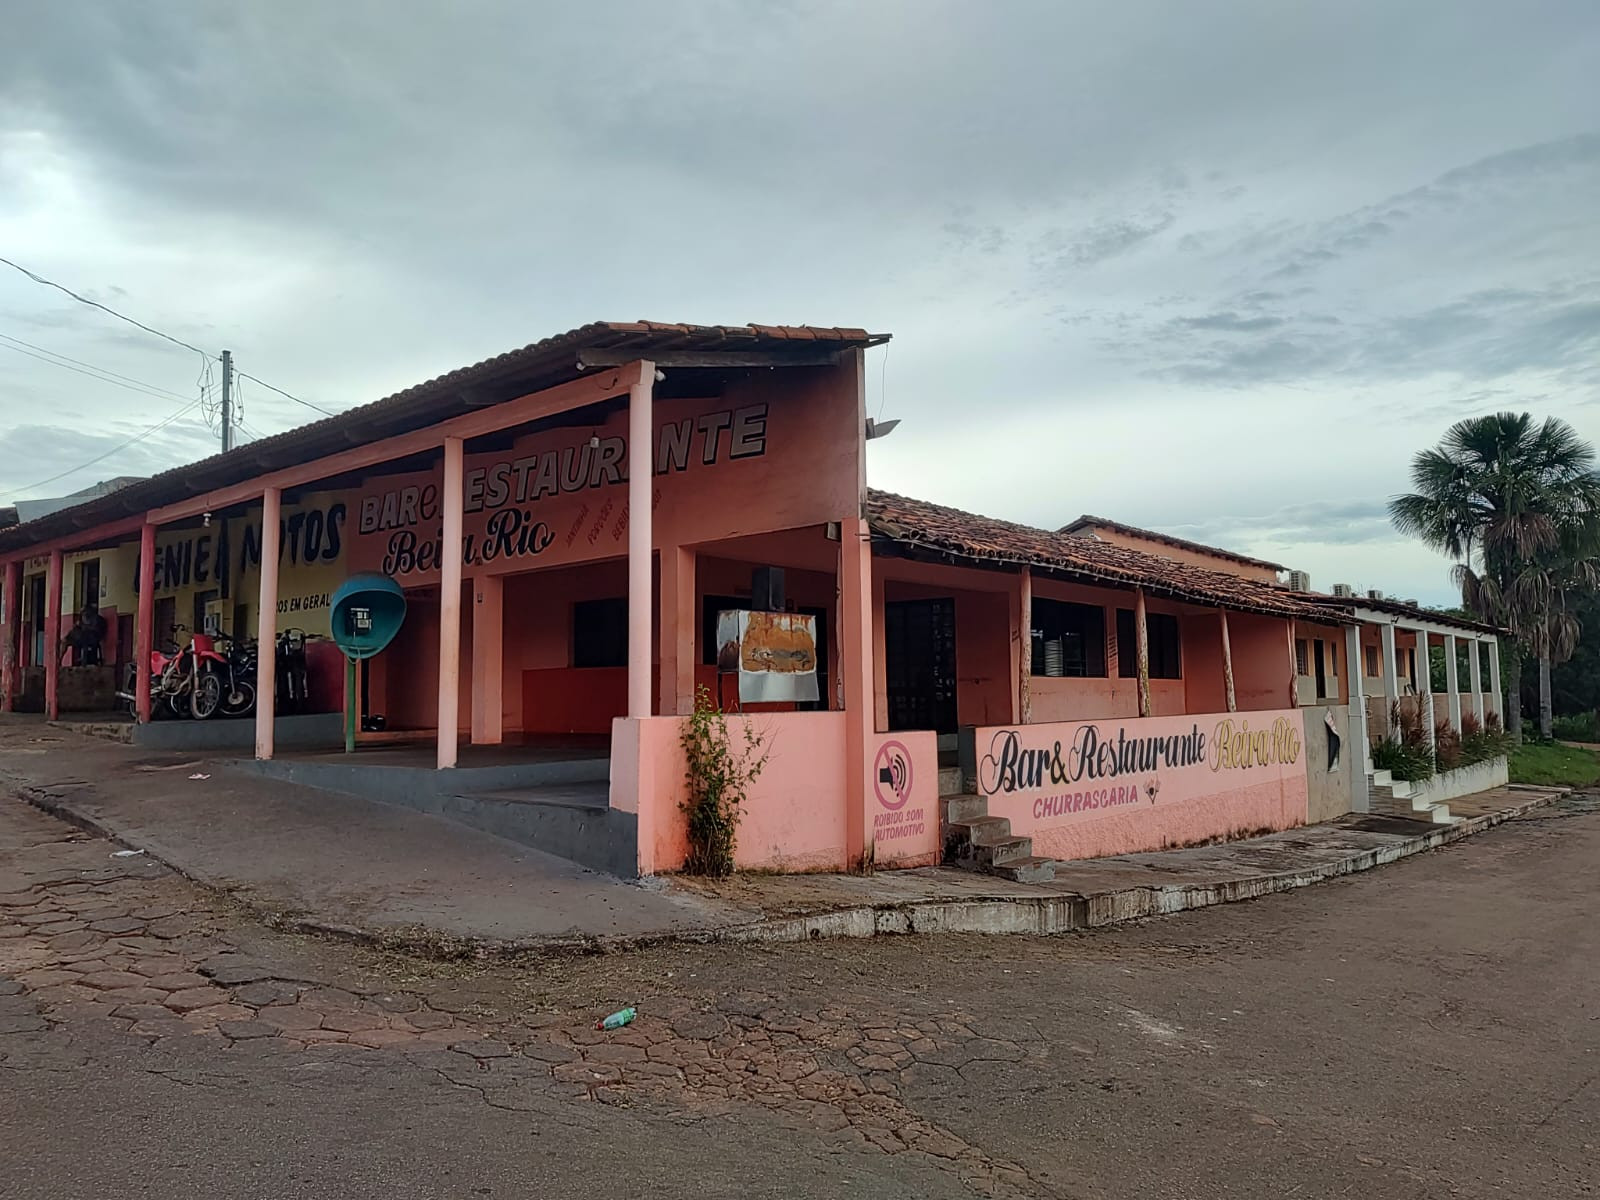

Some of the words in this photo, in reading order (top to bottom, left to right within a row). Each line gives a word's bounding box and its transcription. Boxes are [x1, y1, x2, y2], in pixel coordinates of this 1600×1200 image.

[359, 486, 418, 535] BAR
[439, 402, 768, 519] ESTAURNTE
[240, 503, 346, 573] MTOS
[482, 508, 556, 562] Rio
[290, 597, 301, 612] EM
[303, 593, 331, 611] GERAL
[980, 730, 1050, 796] Bar
[1069, 724, 1206, 782] Restaurante
[1208, 718, 1270, 773] Beira
[1269, 716, 1300, 764] Rio
[873, 811, 904, 828] ROIBIDO
[905, 808, 924, 822] SOM
[1032, 785, 1139, 819] CHURRASCARIA
[874, 822, 925, 843] AUTOMOTIVO
